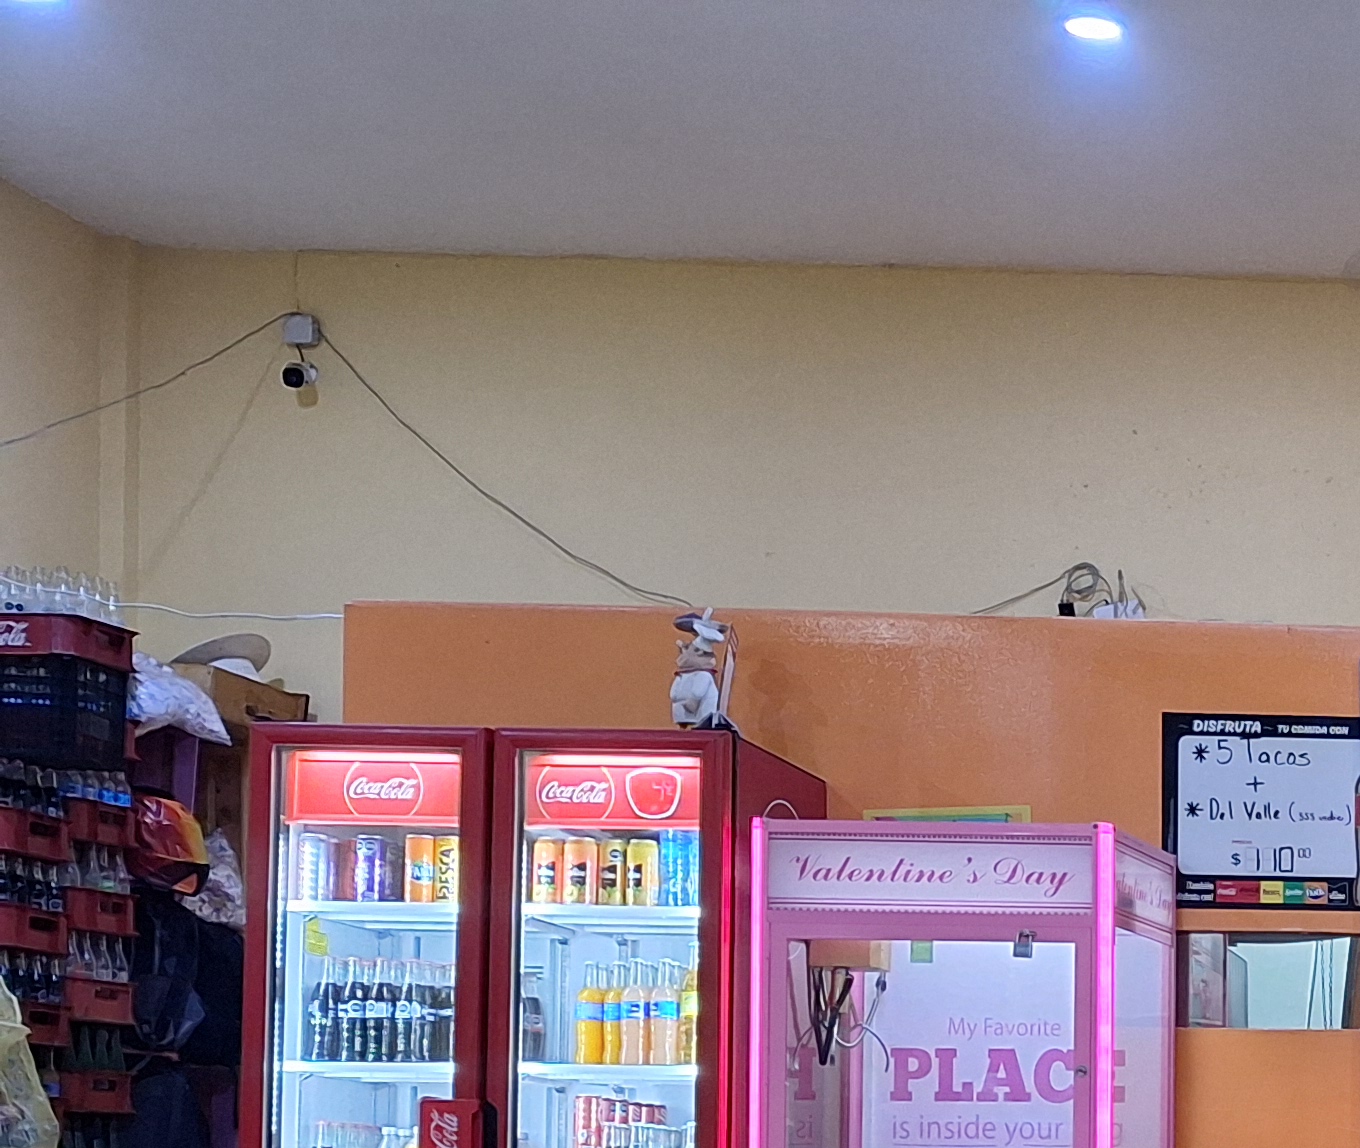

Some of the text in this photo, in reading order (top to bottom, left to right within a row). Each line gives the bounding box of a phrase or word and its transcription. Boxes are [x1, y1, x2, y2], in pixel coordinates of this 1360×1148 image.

[1192, 720, 1261, 734] DISFRUTA
[1277, 725, 1289, 734] TU
[1240, 736, 1311, 766] Tacos
[1209, 798, 1234, 821] Del
[1243, 802, 1280, 821] Valle
[789, 856, 1076, 898] Valentine's Day
[948, 1017, 1061, 1041] My Favorite
[890, 1048, 1125, 1103] PLAC
[892, 1114, 1064, 1146] is inside your
